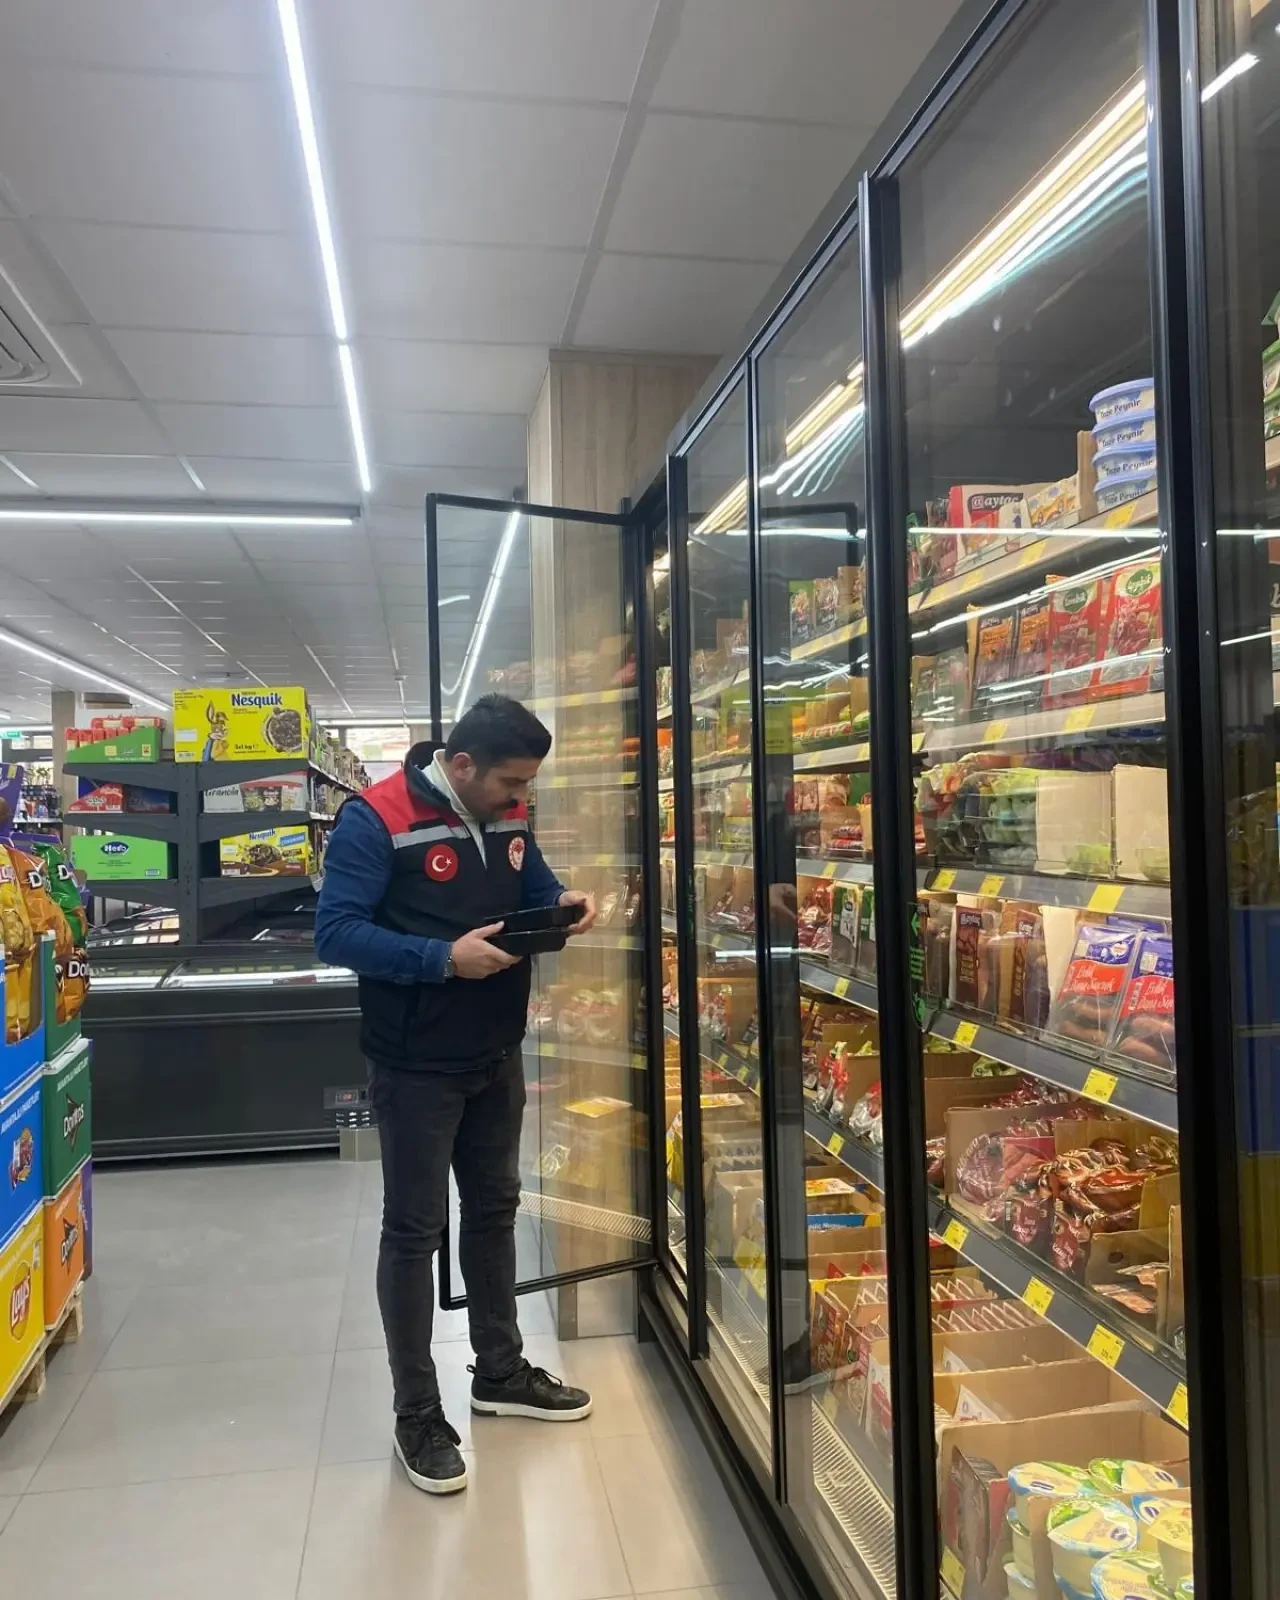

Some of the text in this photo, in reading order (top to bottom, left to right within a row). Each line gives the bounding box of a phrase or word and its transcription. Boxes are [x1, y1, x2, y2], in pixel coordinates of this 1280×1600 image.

[1114, 399, 1141, 413] Peynir
[1117, 430, 1144, 442] Peynir
[231, 693, 283, 709] Nesquik
[63, 1103, 85, 1138] Doritos
